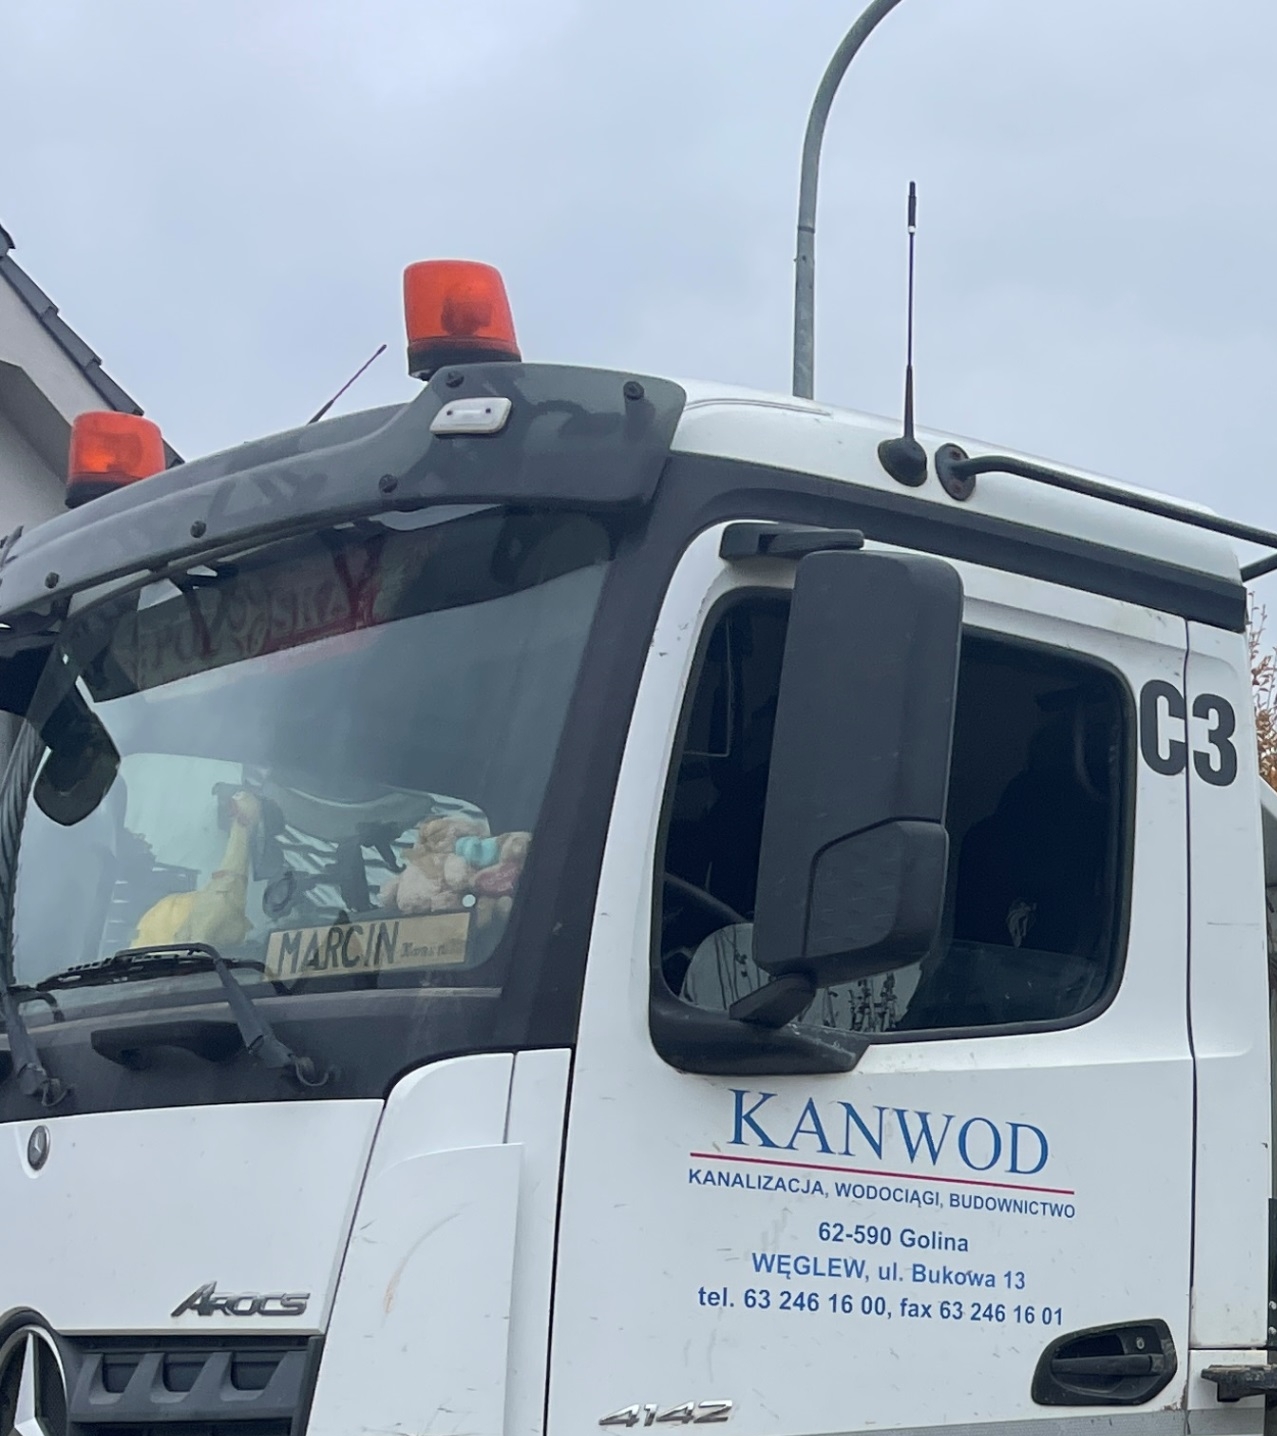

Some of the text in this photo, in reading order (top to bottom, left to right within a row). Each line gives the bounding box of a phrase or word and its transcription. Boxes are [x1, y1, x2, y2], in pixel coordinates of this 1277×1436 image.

[1140, 679, 1237, 786] C3
[278, 921, 399, 976] MARCIN
[727, 1089, 1048, 1175] KANWOD
[689, 1168, 1075, 1219] KANALIZACJA, WODOCIĄGI, BUDOWNICTWO
[818, 1222, 968, 1252] 62-590 Golina
[752, 1253, 1025, 1290] WĘGLEW, ul. Bukowa 13
[699, 1286, 1062, 1327] tel. 63 246 16 00, fax 63 246 16 01
[598, 1400, 733, 1428] 4142
